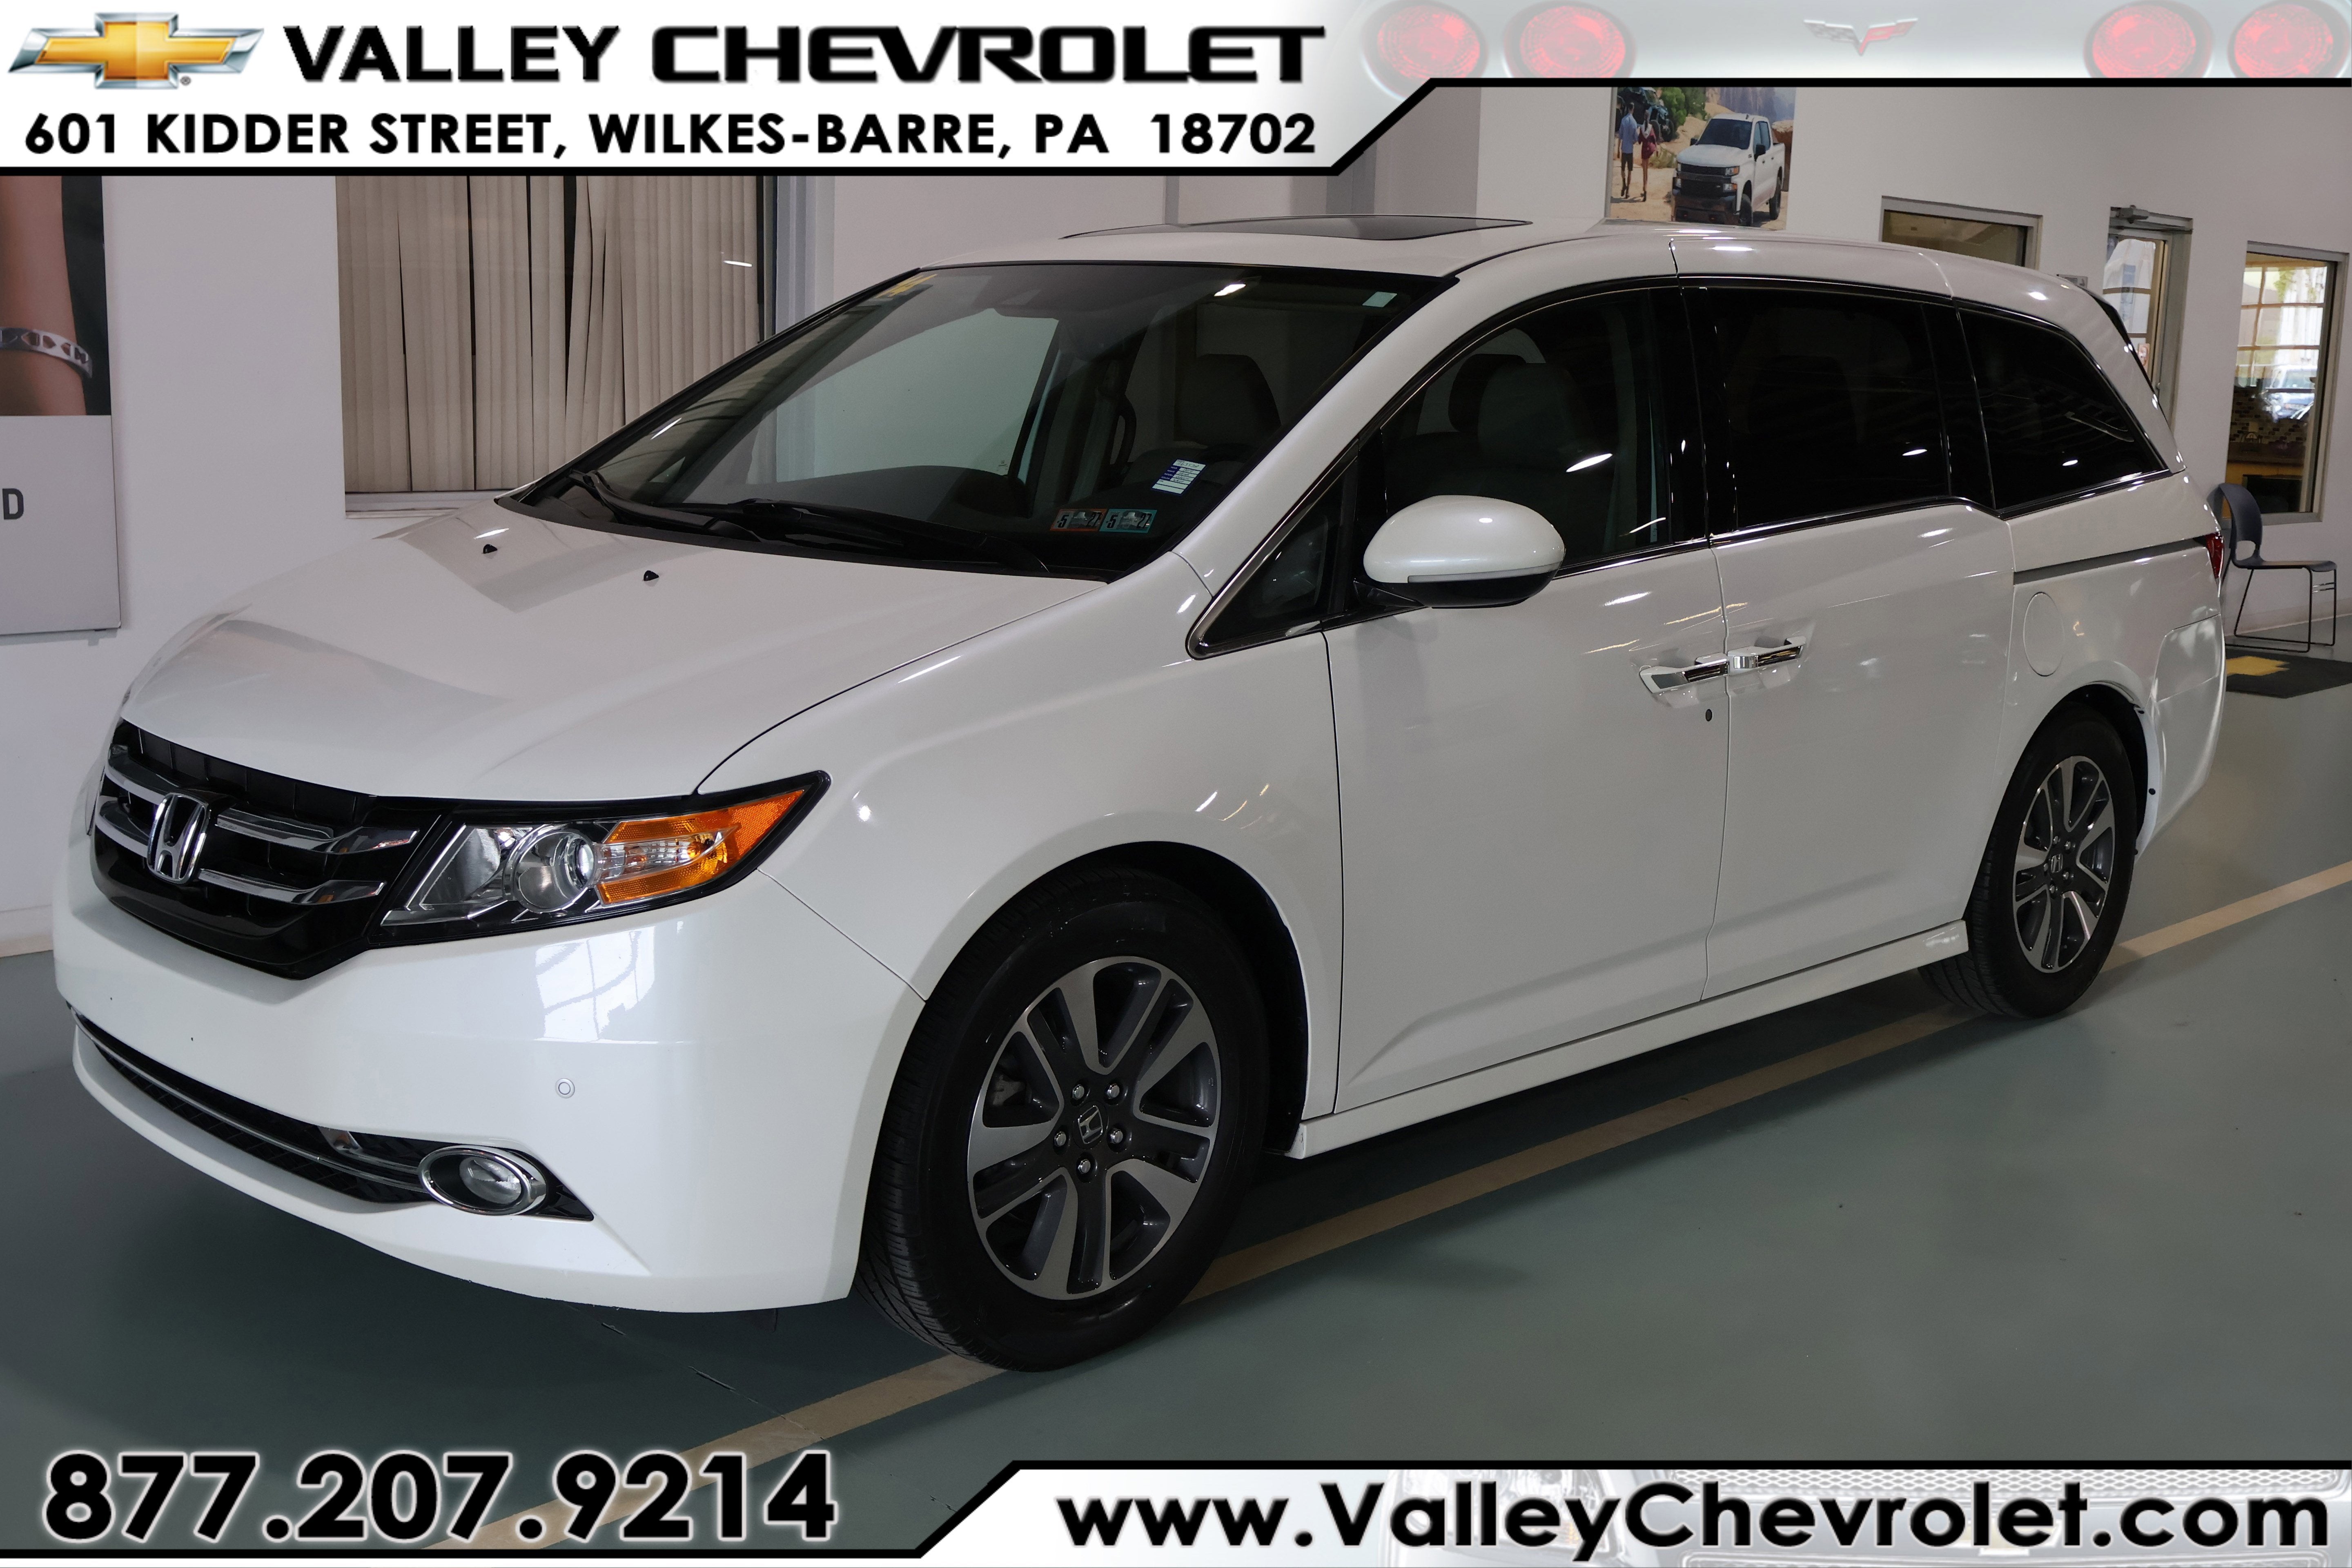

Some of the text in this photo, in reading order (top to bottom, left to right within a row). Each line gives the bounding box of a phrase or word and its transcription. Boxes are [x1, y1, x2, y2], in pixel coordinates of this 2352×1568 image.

[2, 488, 24, 520] D
[1057, 514, 1069, 528] 5
[1107, 514, 1118, 528] 5
